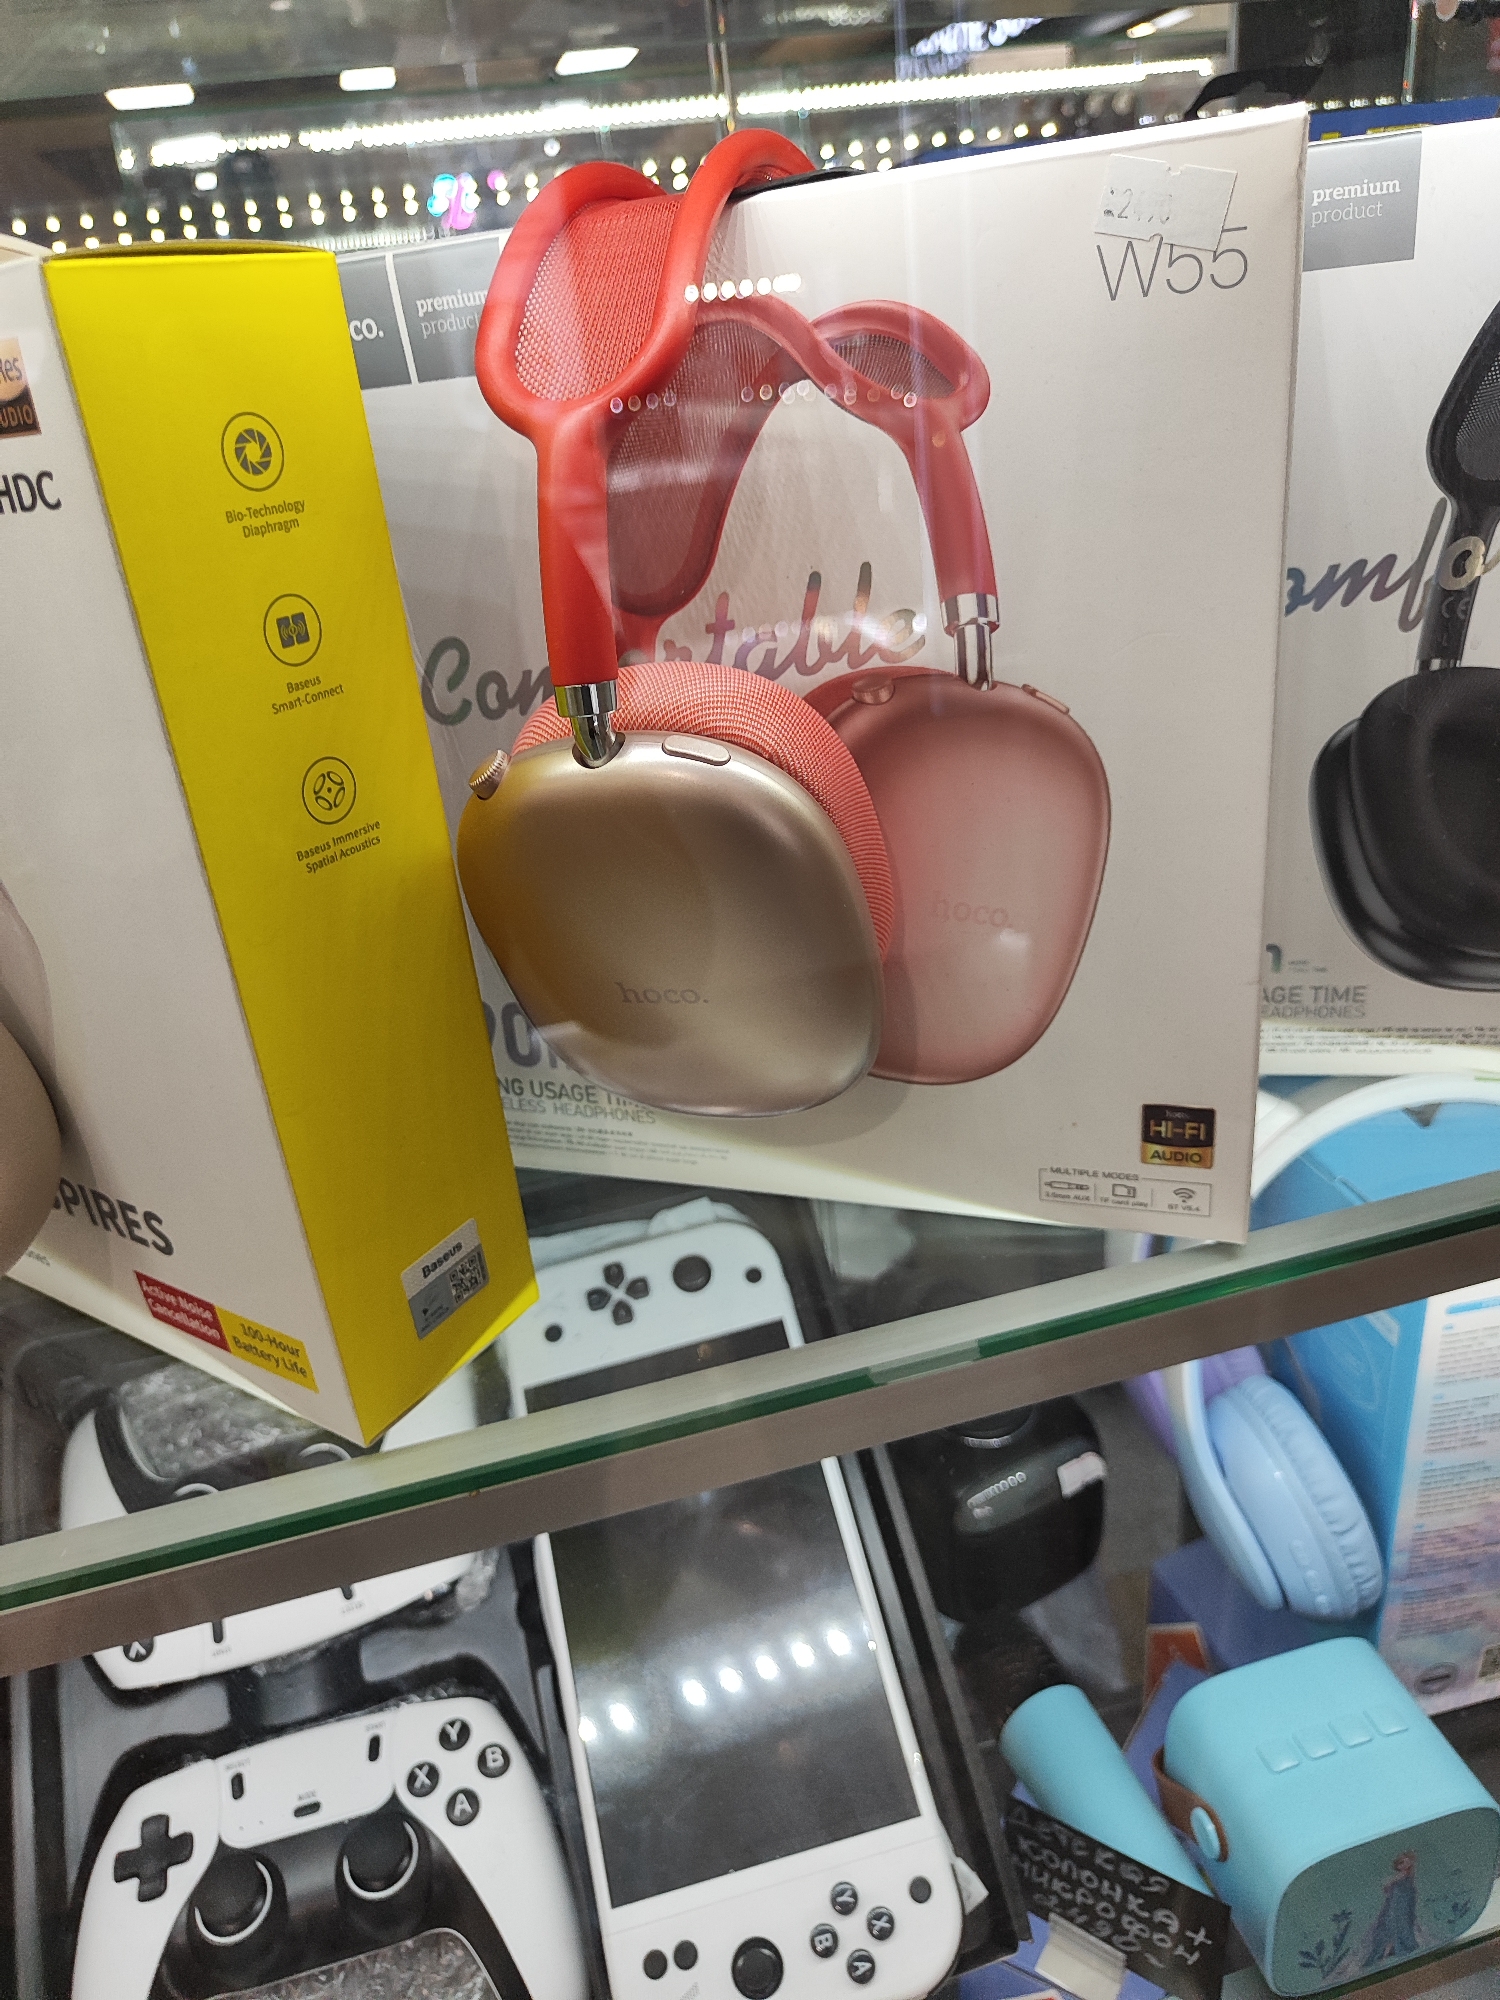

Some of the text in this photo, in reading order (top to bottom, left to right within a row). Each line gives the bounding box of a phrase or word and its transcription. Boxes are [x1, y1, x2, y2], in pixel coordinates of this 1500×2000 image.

[1311, 179, 1401, 207] premium
[1311, 201, 1383, 228] product
[1096, 225, 1248, 301] W55
[225, 499, 305, 524] Bio-Technology
[242, 518, 300, 538] Diaphragm
[286, 675, 322, 694] Baseus
[271, 683, 345, 715] Smart-Connect
[296, 820, 381, 862] Baseus Immersive
[305, 835, 381, 874] Spatial Acoustics
[614, 981, 709, 1004] hoco.
[1309, 984, 1368, 1004] TIME
[529, 1079, 598, 1104] USAGE
[552, 1101, 656, 1125] HEADPHONES
[1150, 1119, 1207, 1141] HI-FI
[1150, 1149, 1202, 1163] AUDIO
[1050, 1167, 1139, 1181] MULTIPLE MODES
[421, 1241, 463, 1279] Baseus
[239, 1322, 301, 1358] 100-Hour
[232, 1335, 308, 1378] Battery Life
[444, 1719, 462, 1743] Y
[486, 1746, 504, 1769] B
[414, 1764, 432, 1790] X
[454, 1792, 473, 1817] A
[835, 1889, 856, 1903] Y
[871, 1914, 892, 1934] X
[813, 1932, 834, 1951] B
[852, 1961, 873, 1978] A
